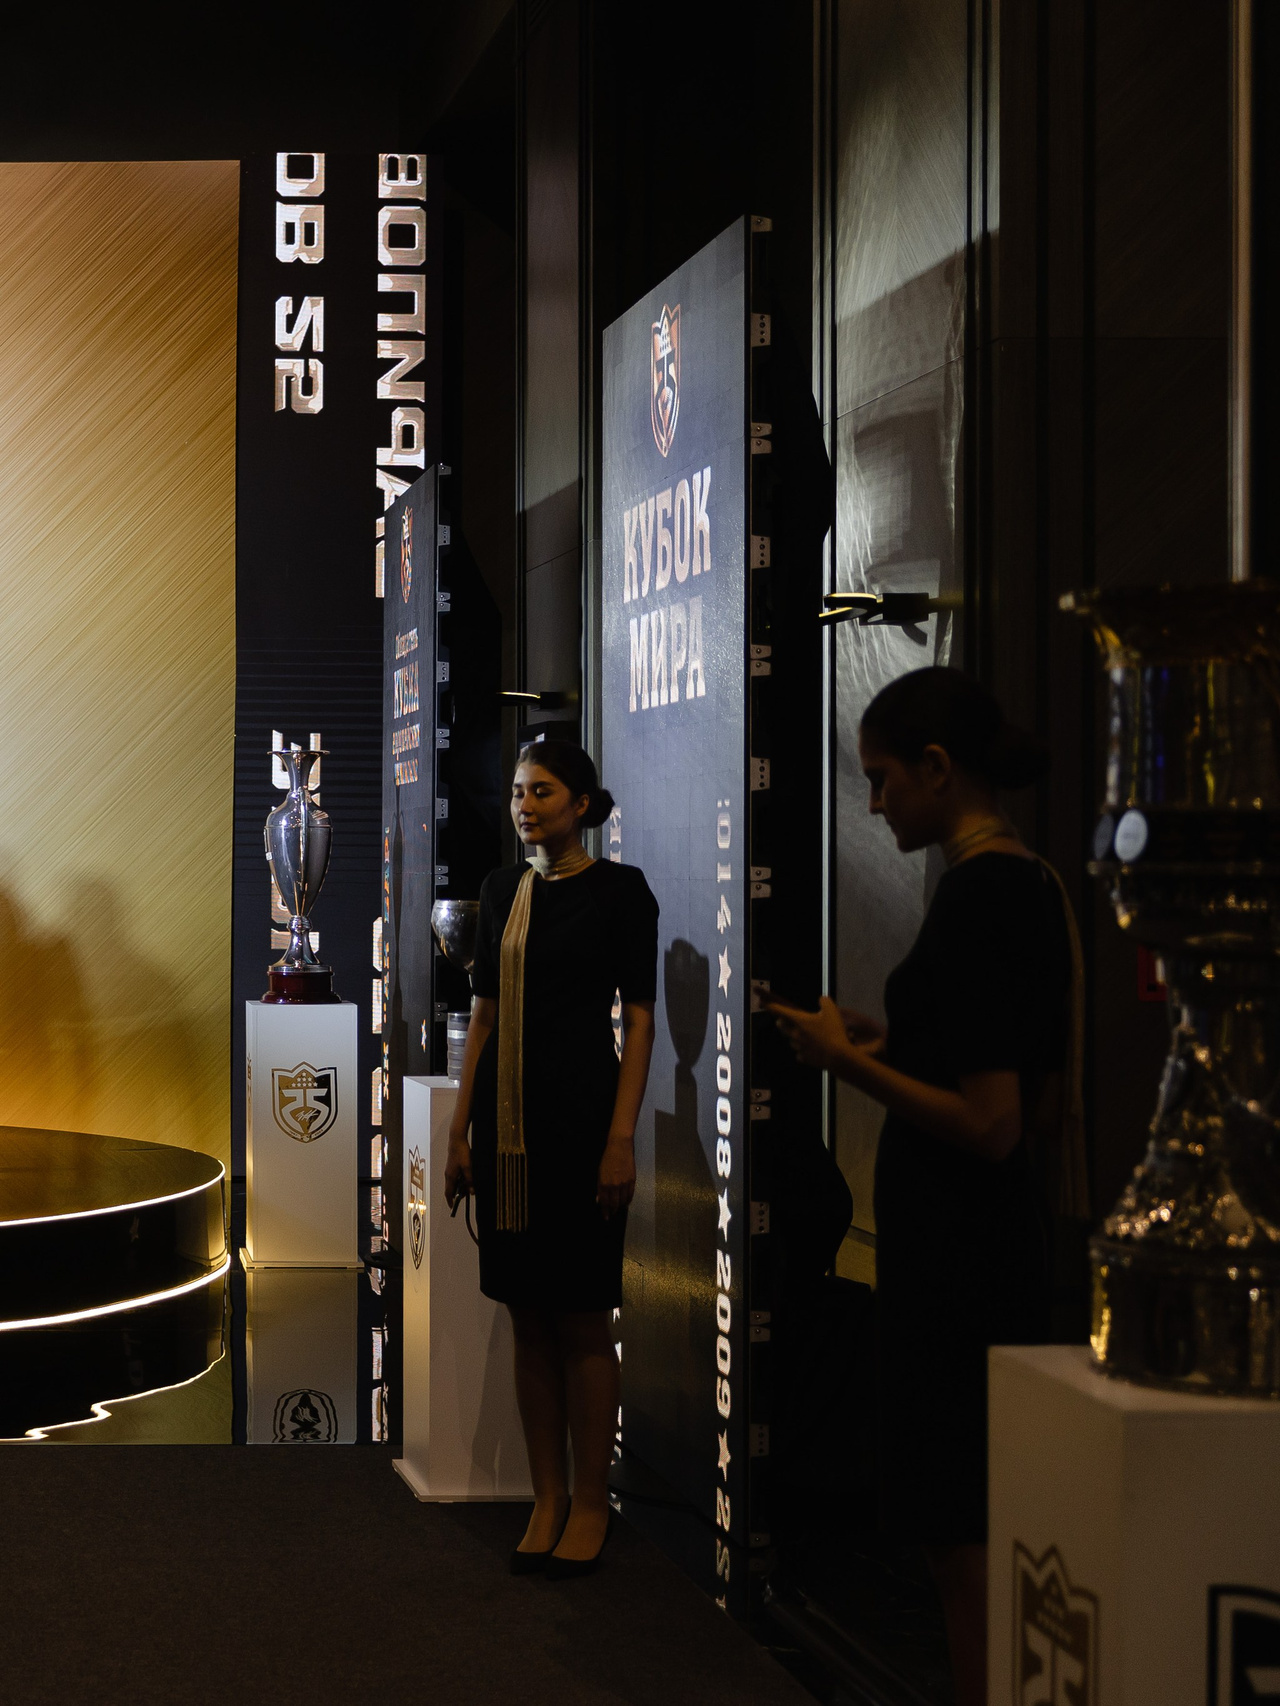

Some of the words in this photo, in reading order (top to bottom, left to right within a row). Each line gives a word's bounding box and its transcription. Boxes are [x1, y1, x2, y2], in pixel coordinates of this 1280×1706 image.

[623, 466, 712, 605] КУБОК
[628, 595, 706, 714] МИРА
[715, 1011, 732, 1180] 2008
[715, 1248, 732, 1421] 2009
